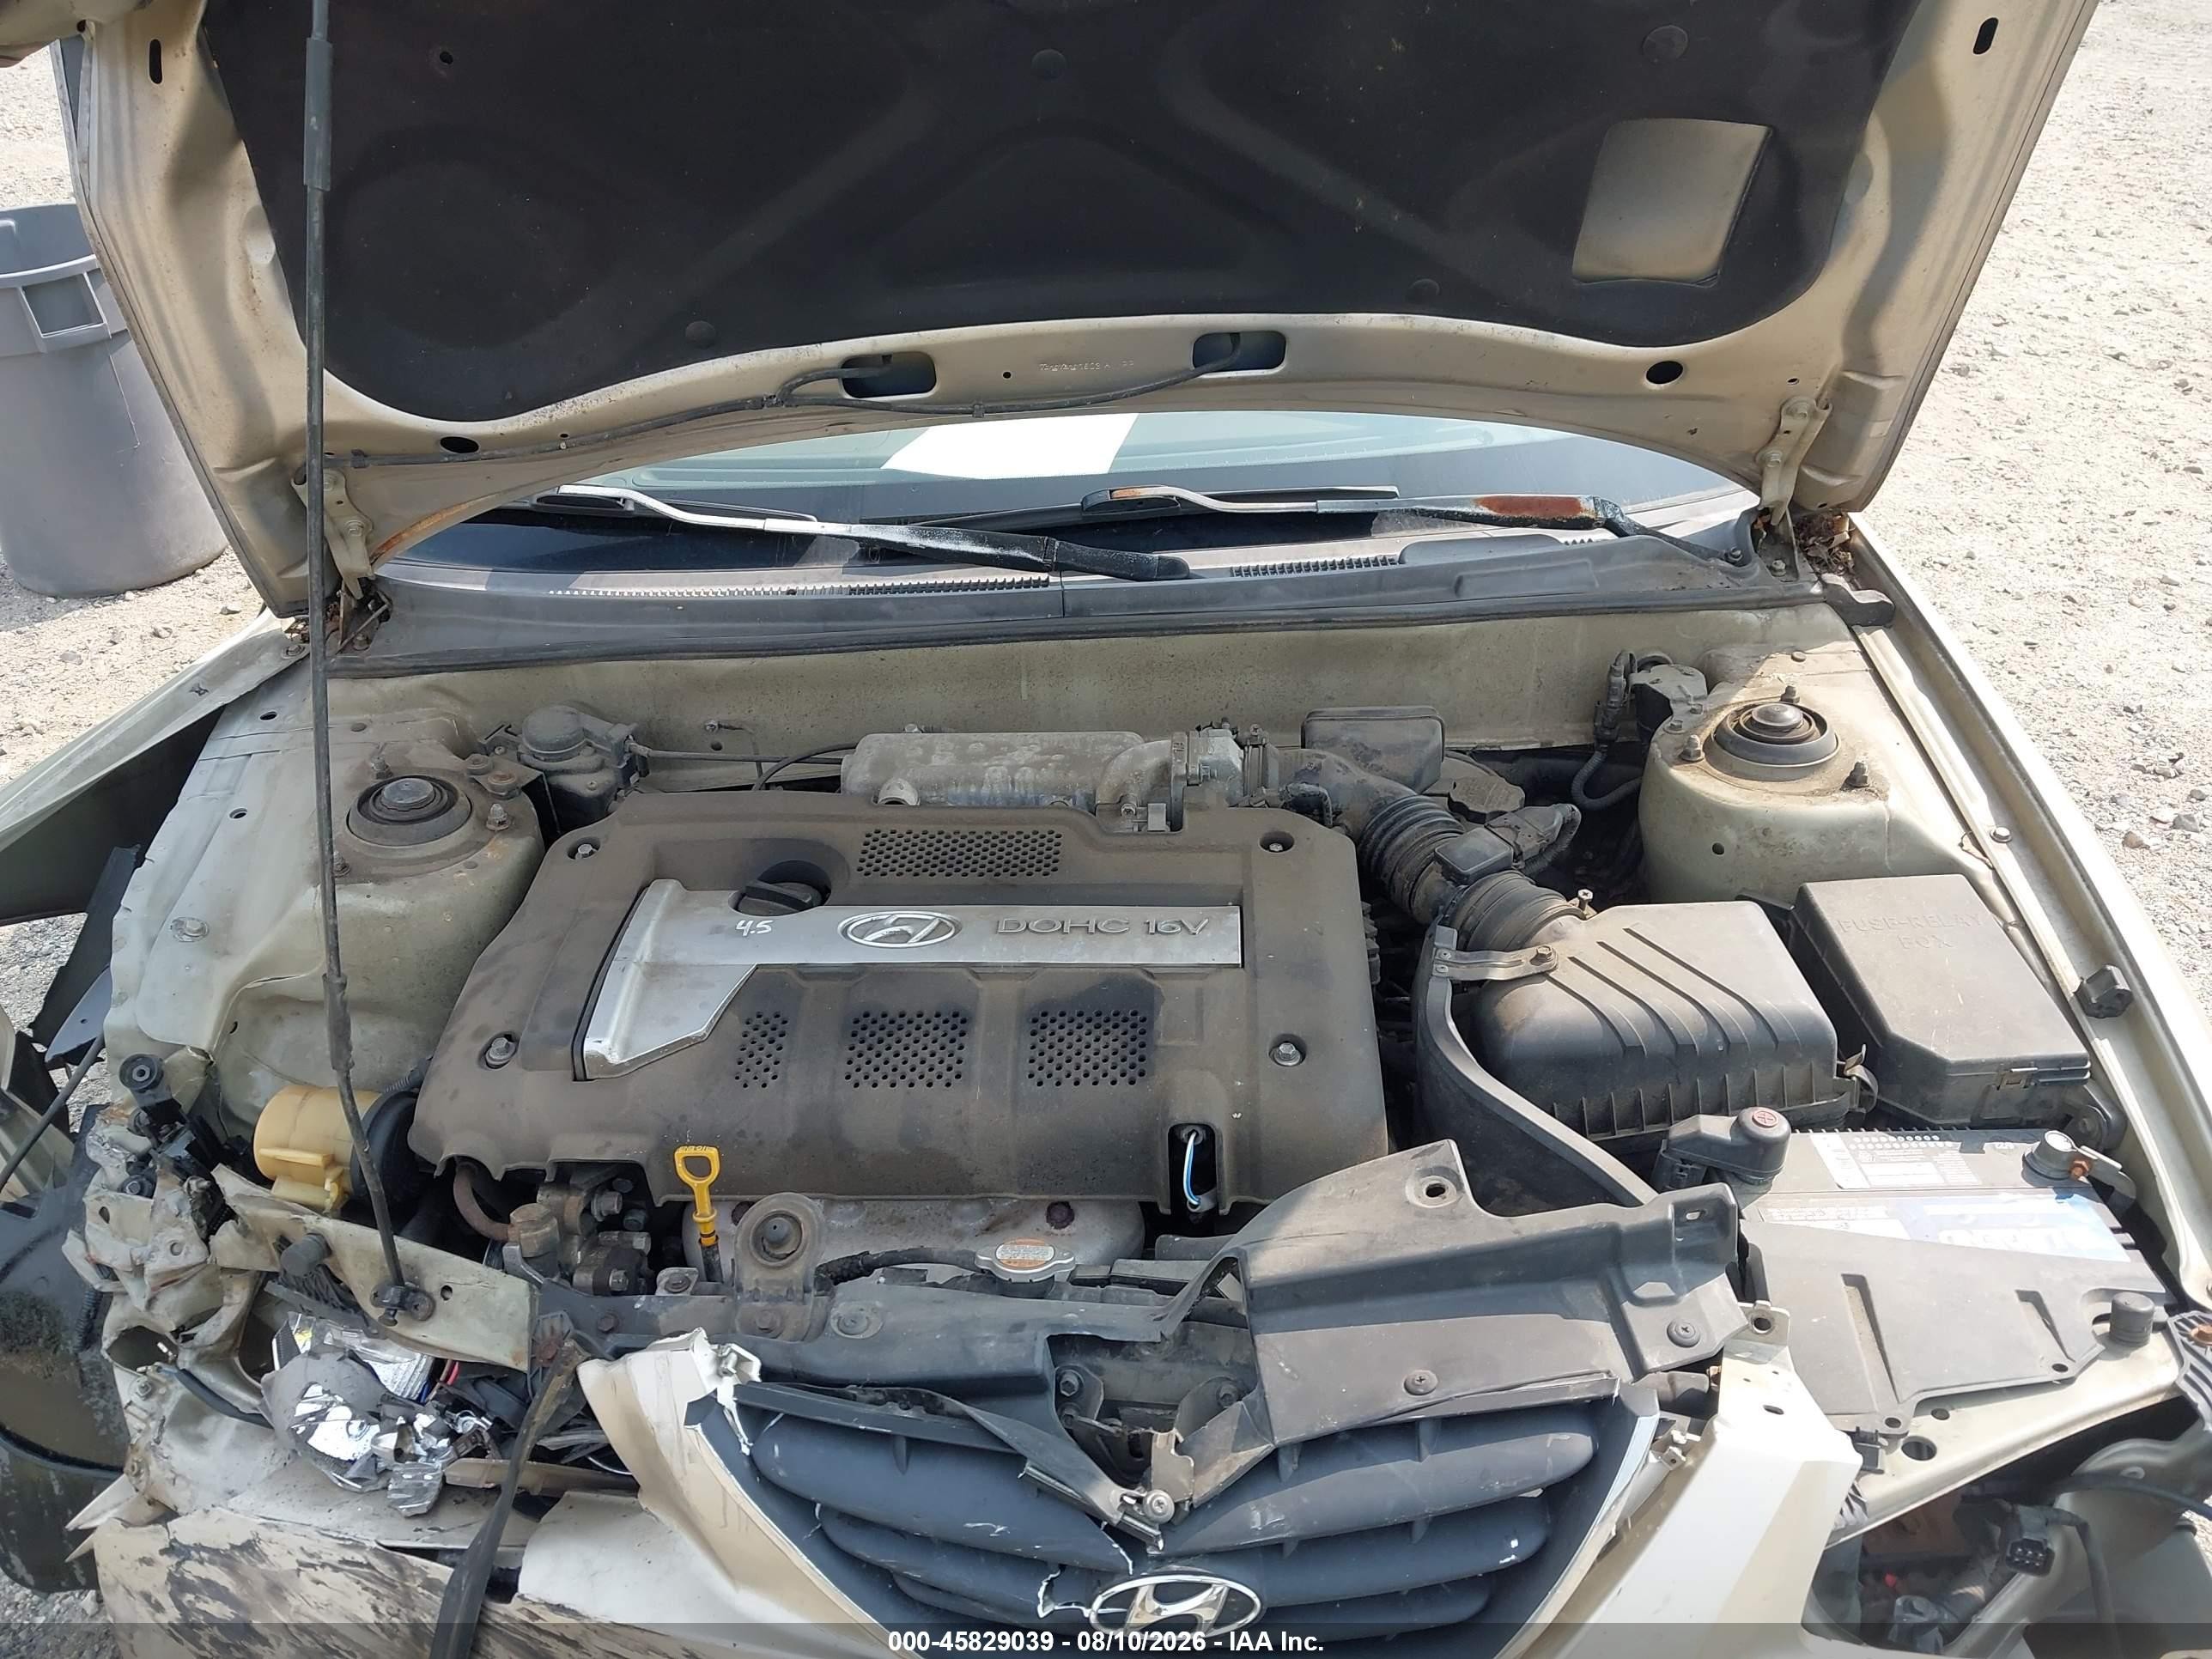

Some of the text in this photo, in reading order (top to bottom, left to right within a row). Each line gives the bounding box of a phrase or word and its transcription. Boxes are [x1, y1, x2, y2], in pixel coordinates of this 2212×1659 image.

[735, 920, 774, 937] 4.5
[997, 917, 1209, 935] DOHC 16V
